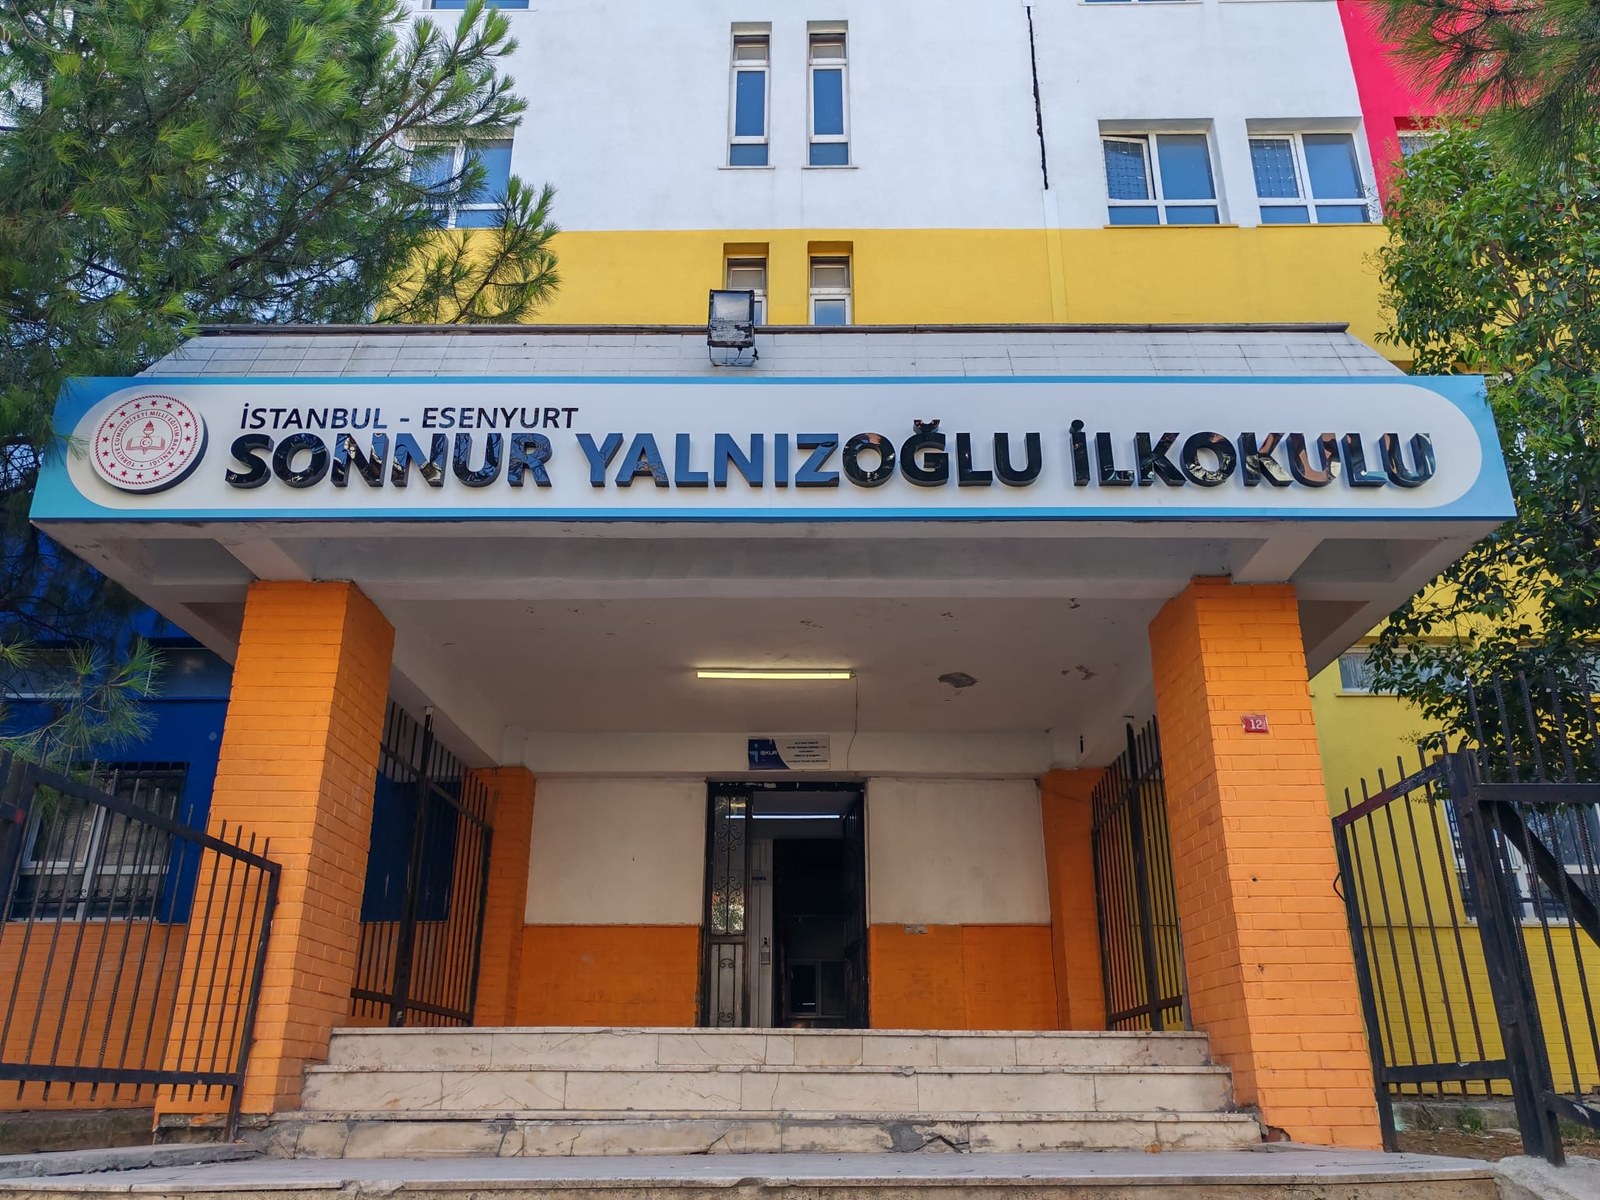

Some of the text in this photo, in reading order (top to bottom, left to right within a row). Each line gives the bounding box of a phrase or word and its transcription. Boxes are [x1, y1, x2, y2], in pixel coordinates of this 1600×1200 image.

[114, 412, 148, 446] CUMHURİYETİ
[149, 411, 168, 419] MİLLİ
[167, 417, 180, 437] EĞİTİM
[240, 402, 388, 429] İSTANBUL
[421, 406, 579, 429] ESENYURT
[224, 419, 1437, 488] SONNUR YALNIZOĞLU İLKOKULU
[1250, 719, 1262, 729] 12
